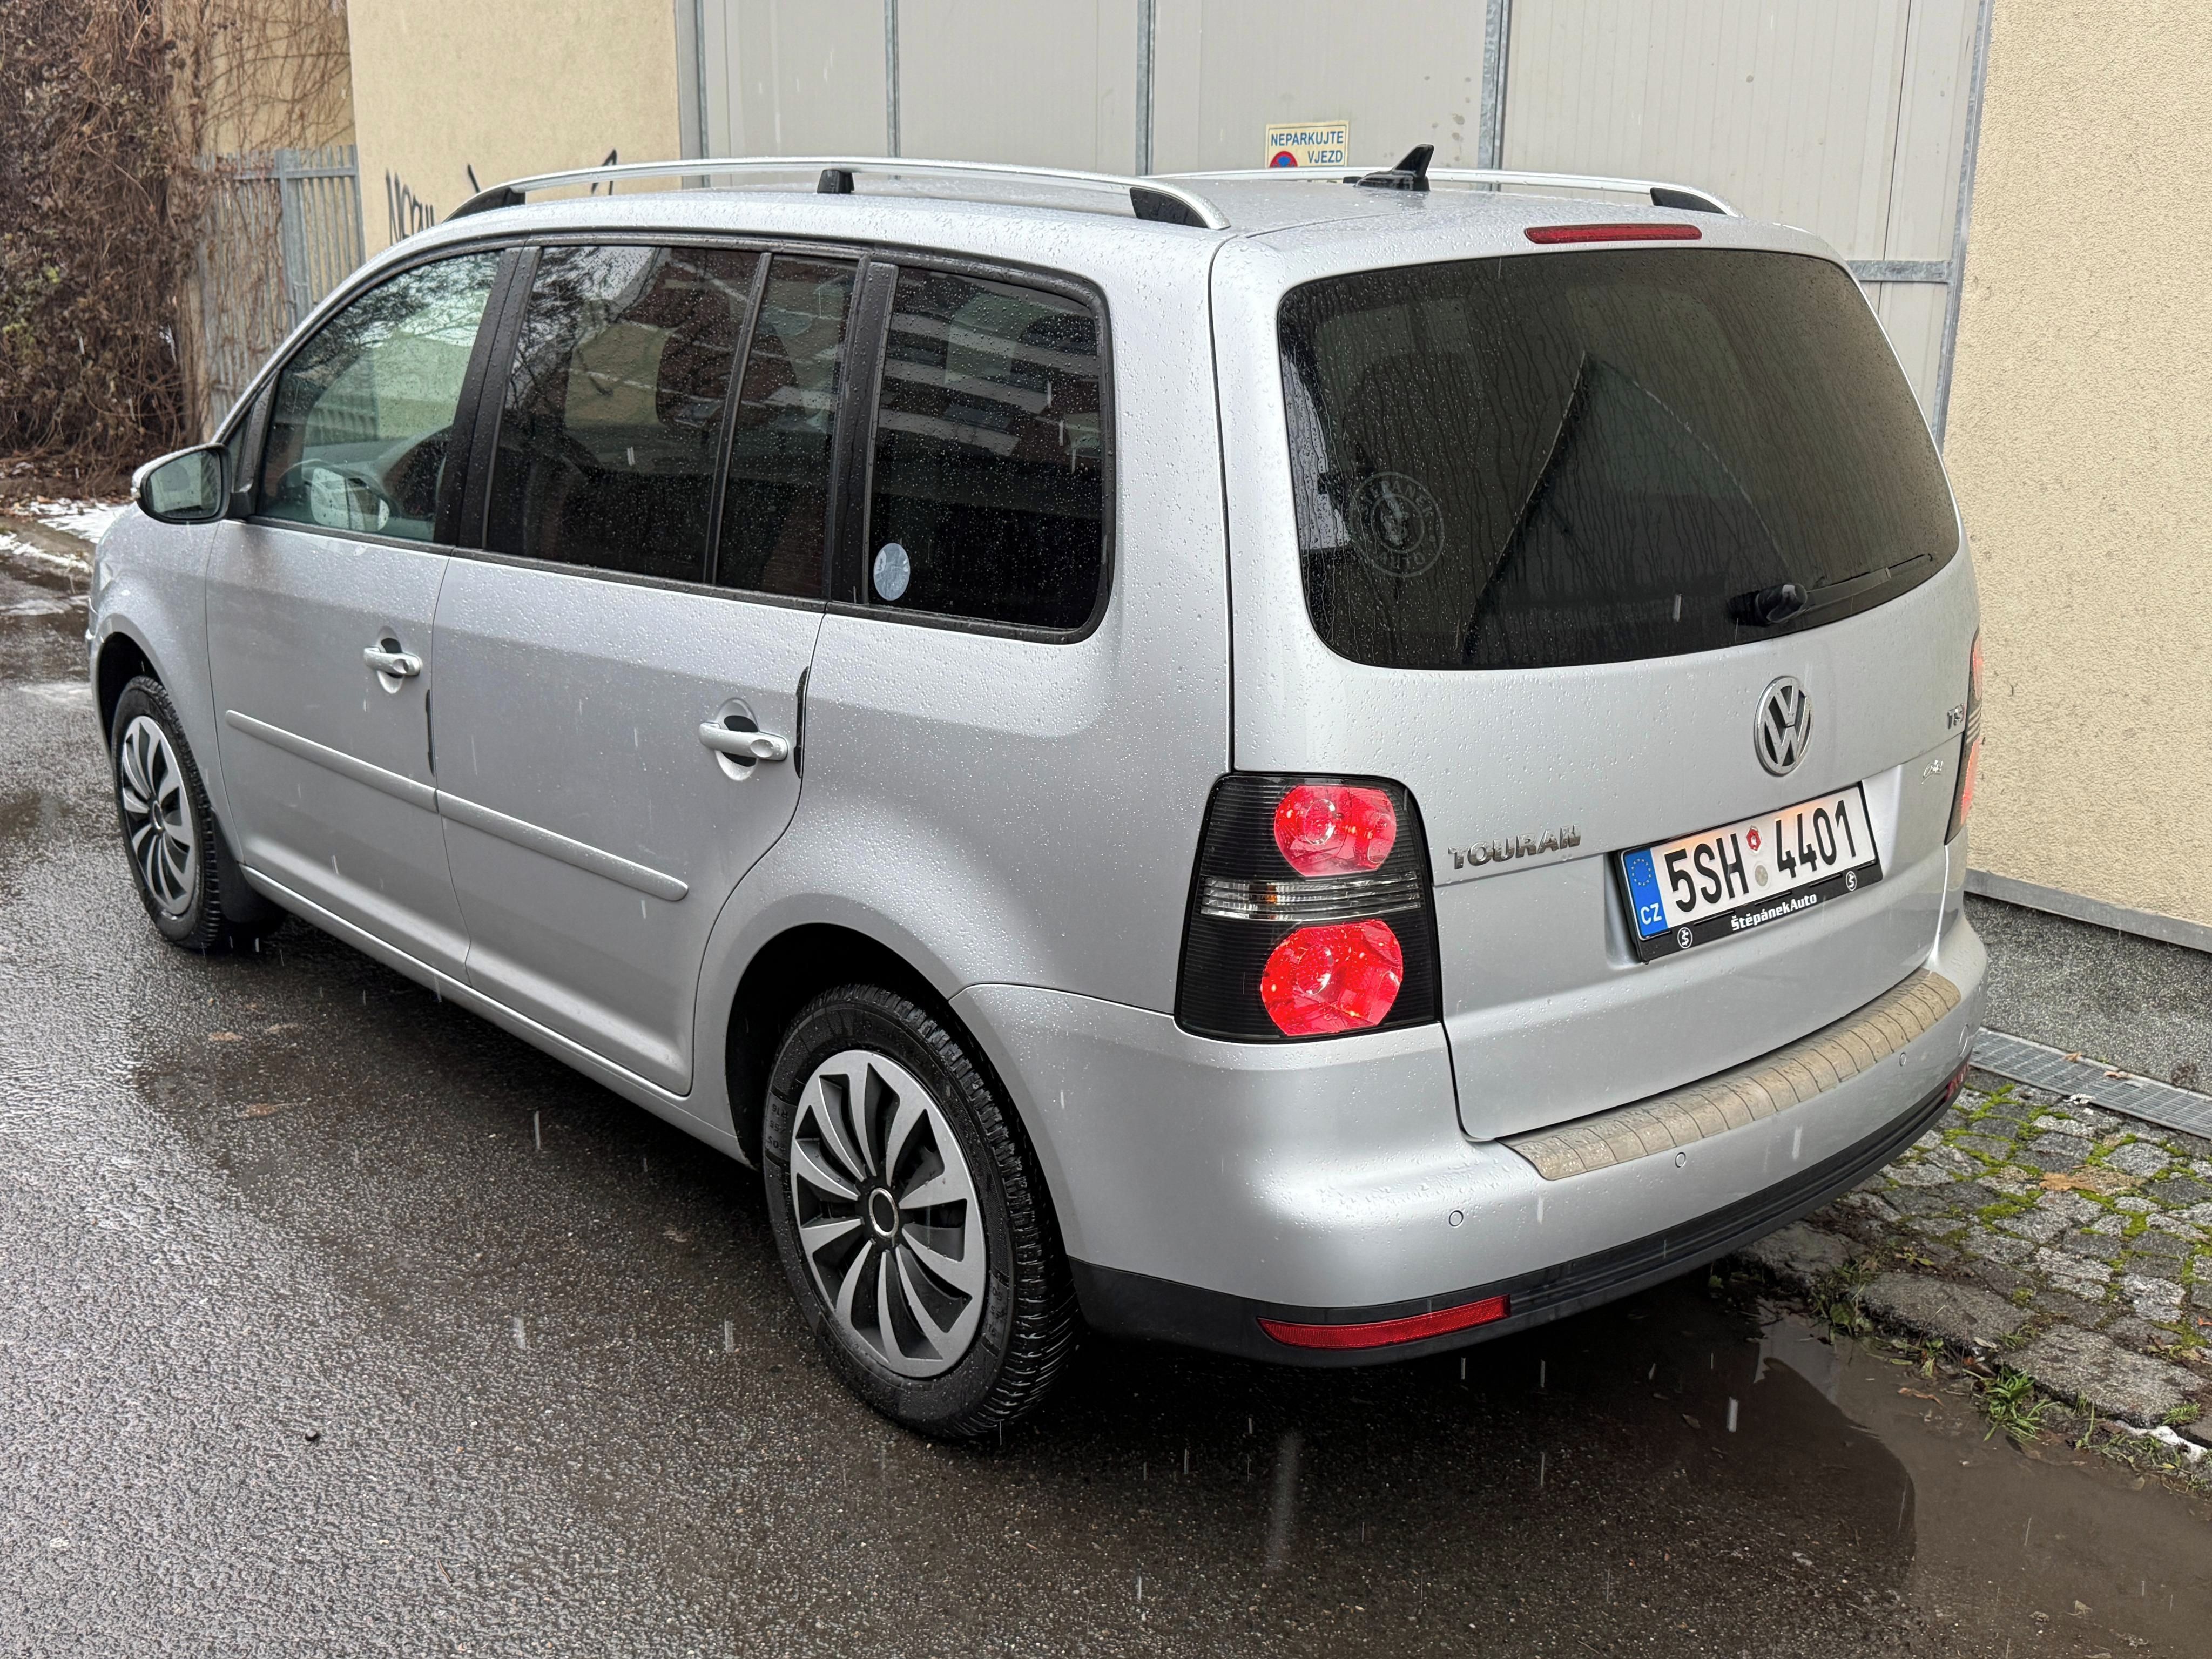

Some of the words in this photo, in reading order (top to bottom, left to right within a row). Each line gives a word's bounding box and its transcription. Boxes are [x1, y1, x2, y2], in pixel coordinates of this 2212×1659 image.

[1271, 131, 1344, 146] NEPARKUJTE
[1308, 150, 1343, 164] VJEZD
[1448, 823, 1581, 869] TOURAN
[1664, 833, 1750, 913] 5SH
[1775, 799, 1857, 879] 4401
[1640, 902, 1663, 925] CZ
